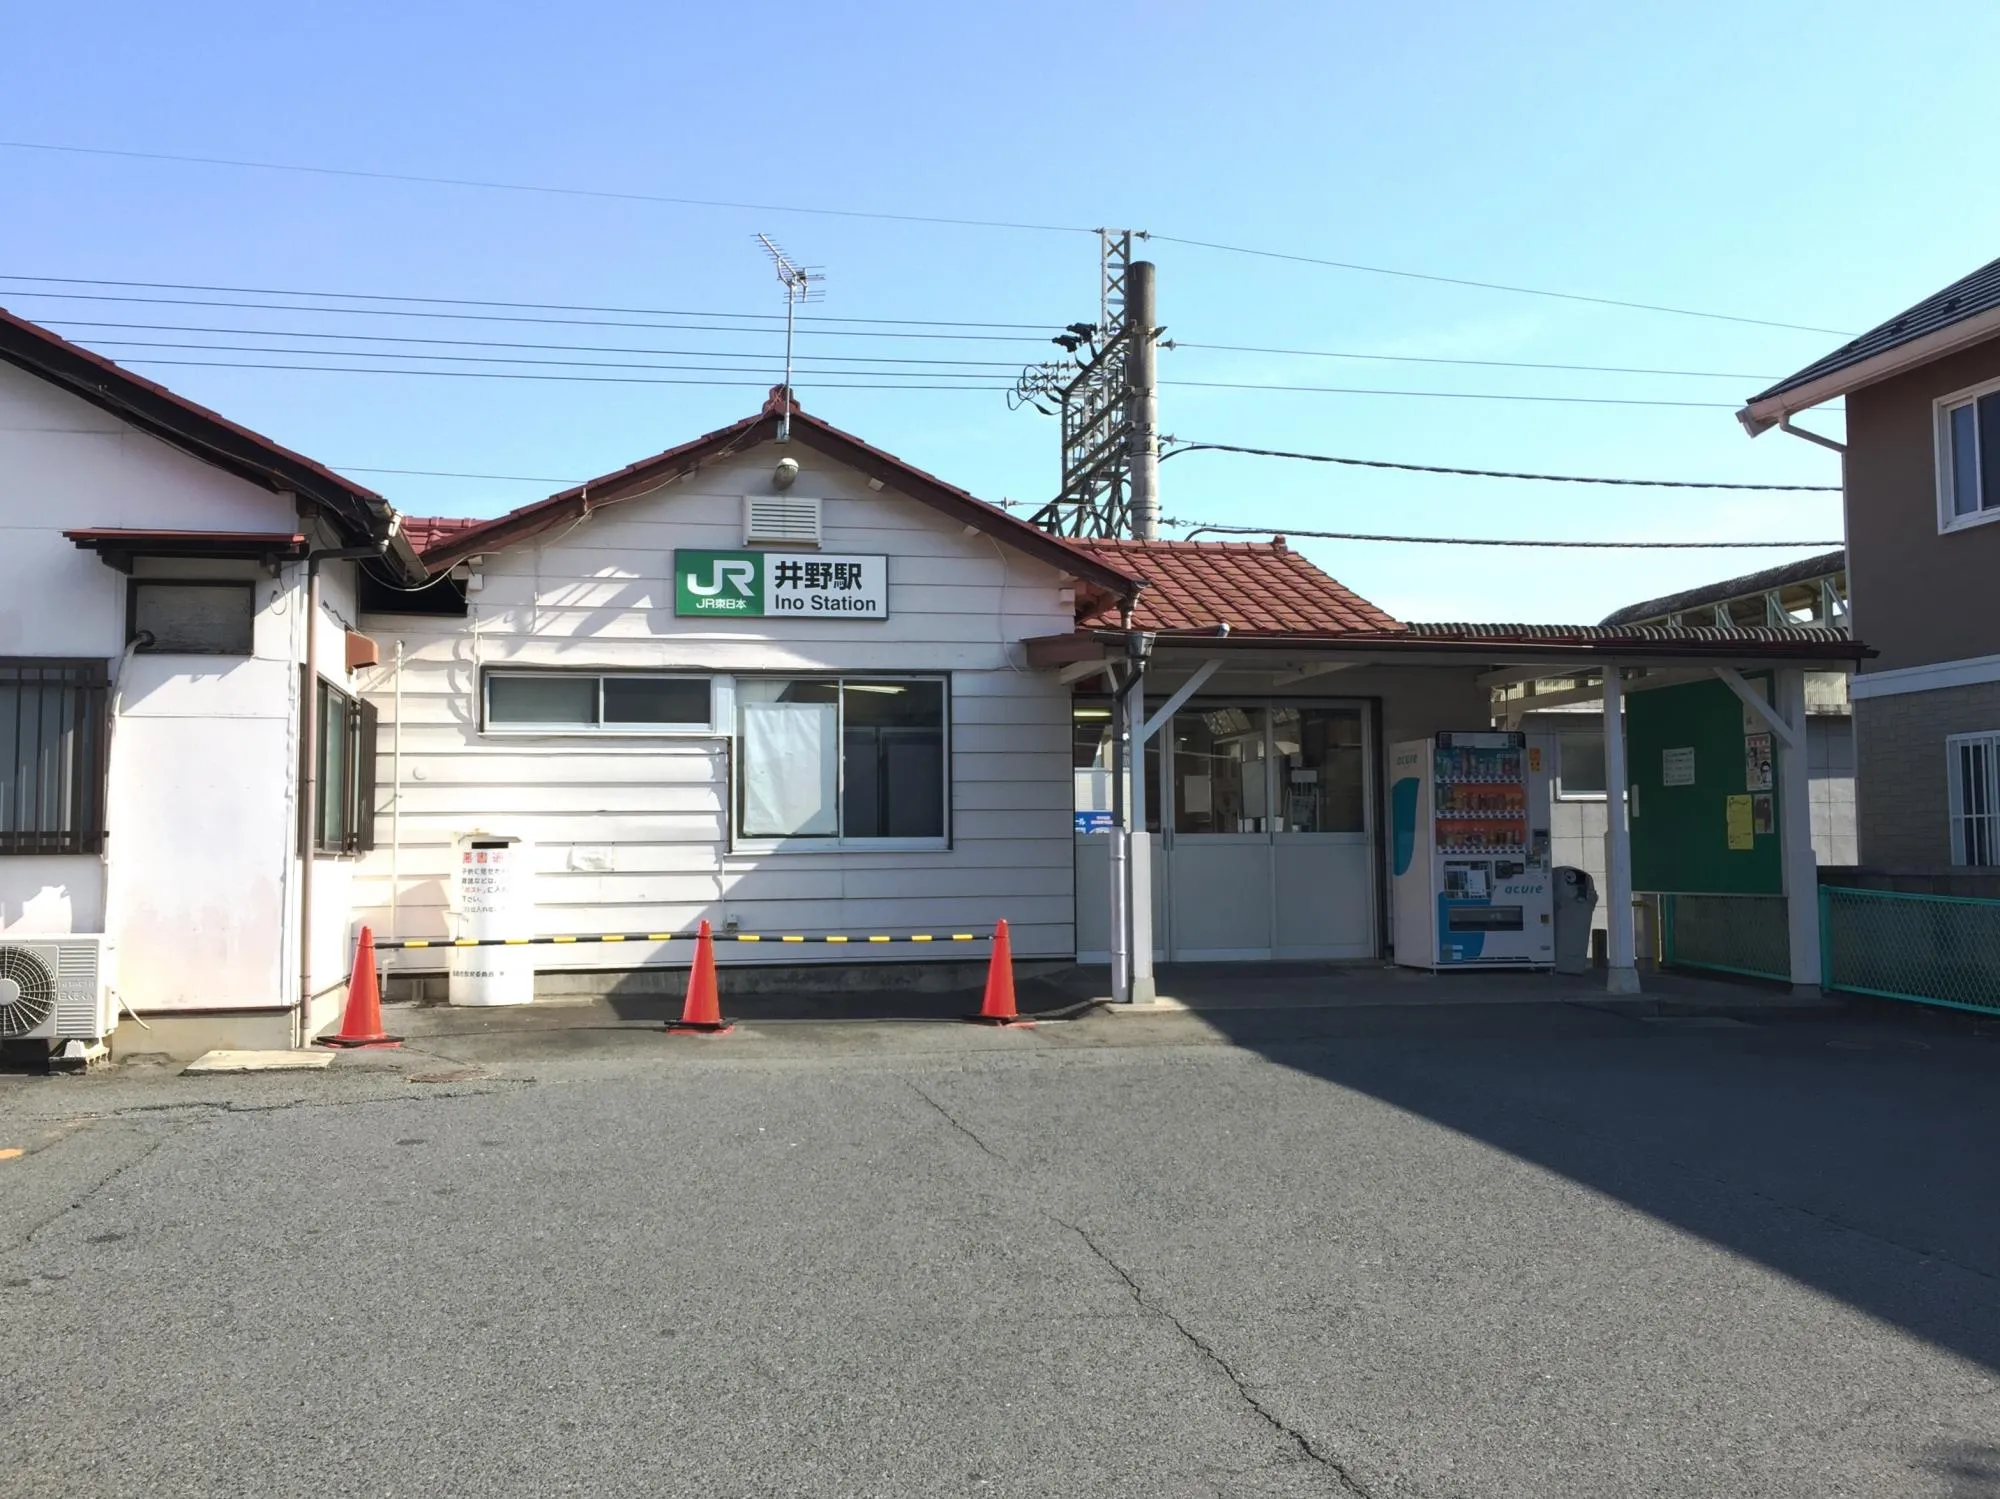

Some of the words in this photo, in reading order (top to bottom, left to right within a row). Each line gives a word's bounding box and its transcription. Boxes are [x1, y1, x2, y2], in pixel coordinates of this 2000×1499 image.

[687, 560, 755, 597] JR
[775, 561, 863, 591] 井野駅
[696, 599, 747, 610] JR東日本
[775, 594, 804, 610] Ino
[811, 595, 877, 611] Station
[1504, 885, 1544, 895] acure
